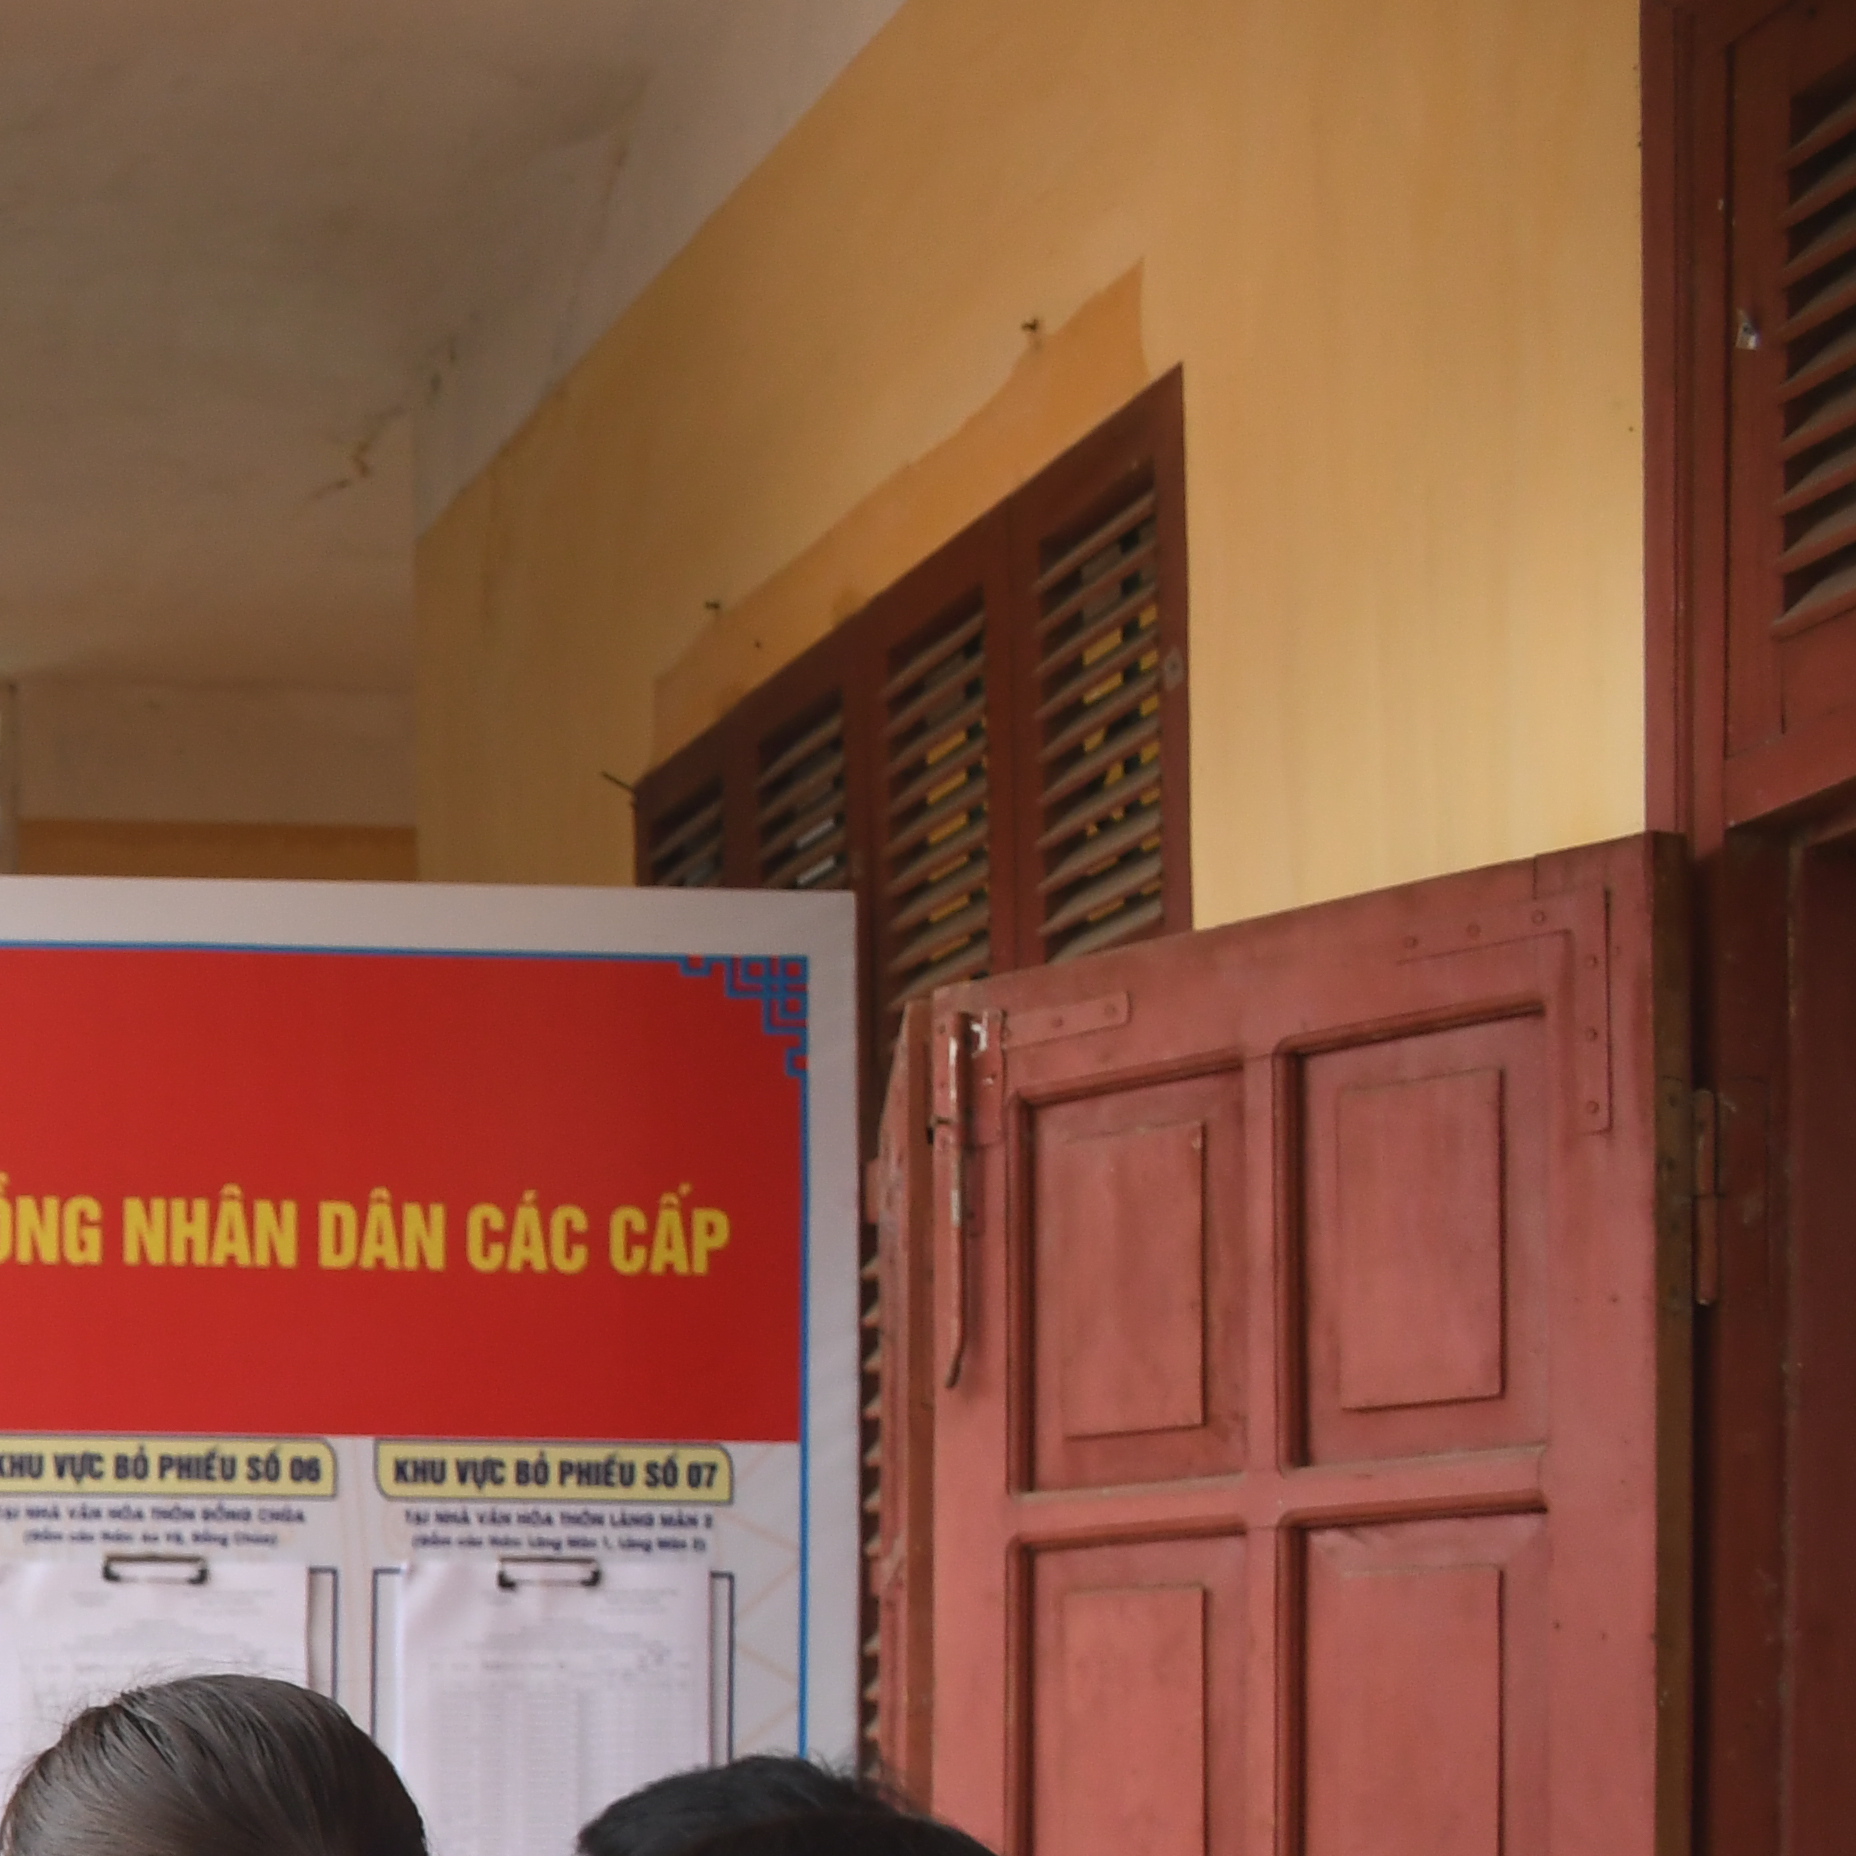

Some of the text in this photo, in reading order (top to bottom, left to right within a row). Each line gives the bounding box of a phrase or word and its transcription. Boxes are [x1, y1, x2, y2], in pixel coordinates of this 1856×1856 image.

[124, 1184, 298, 1267] NHÂN
[320, 1187, 446, 1270] DÂN
[468, 1191, 588, 1273] CÁC
[611, 1188, 729, 1274] CẤP
[54, 1451, 105, 1485] VỰC
[158, 1447, 237, 1482] PHIẾU
[246, 1446, 282, 1483] SỐ
[393, 1459, 447, 1486] KHU
[456, 1457, 506, 1491] VỰC
[558, 1453, 636, 1489] PHIẾU
[644, 1451, 679, 1489] SỐ
[686, 1461, 719, 1490] 07
